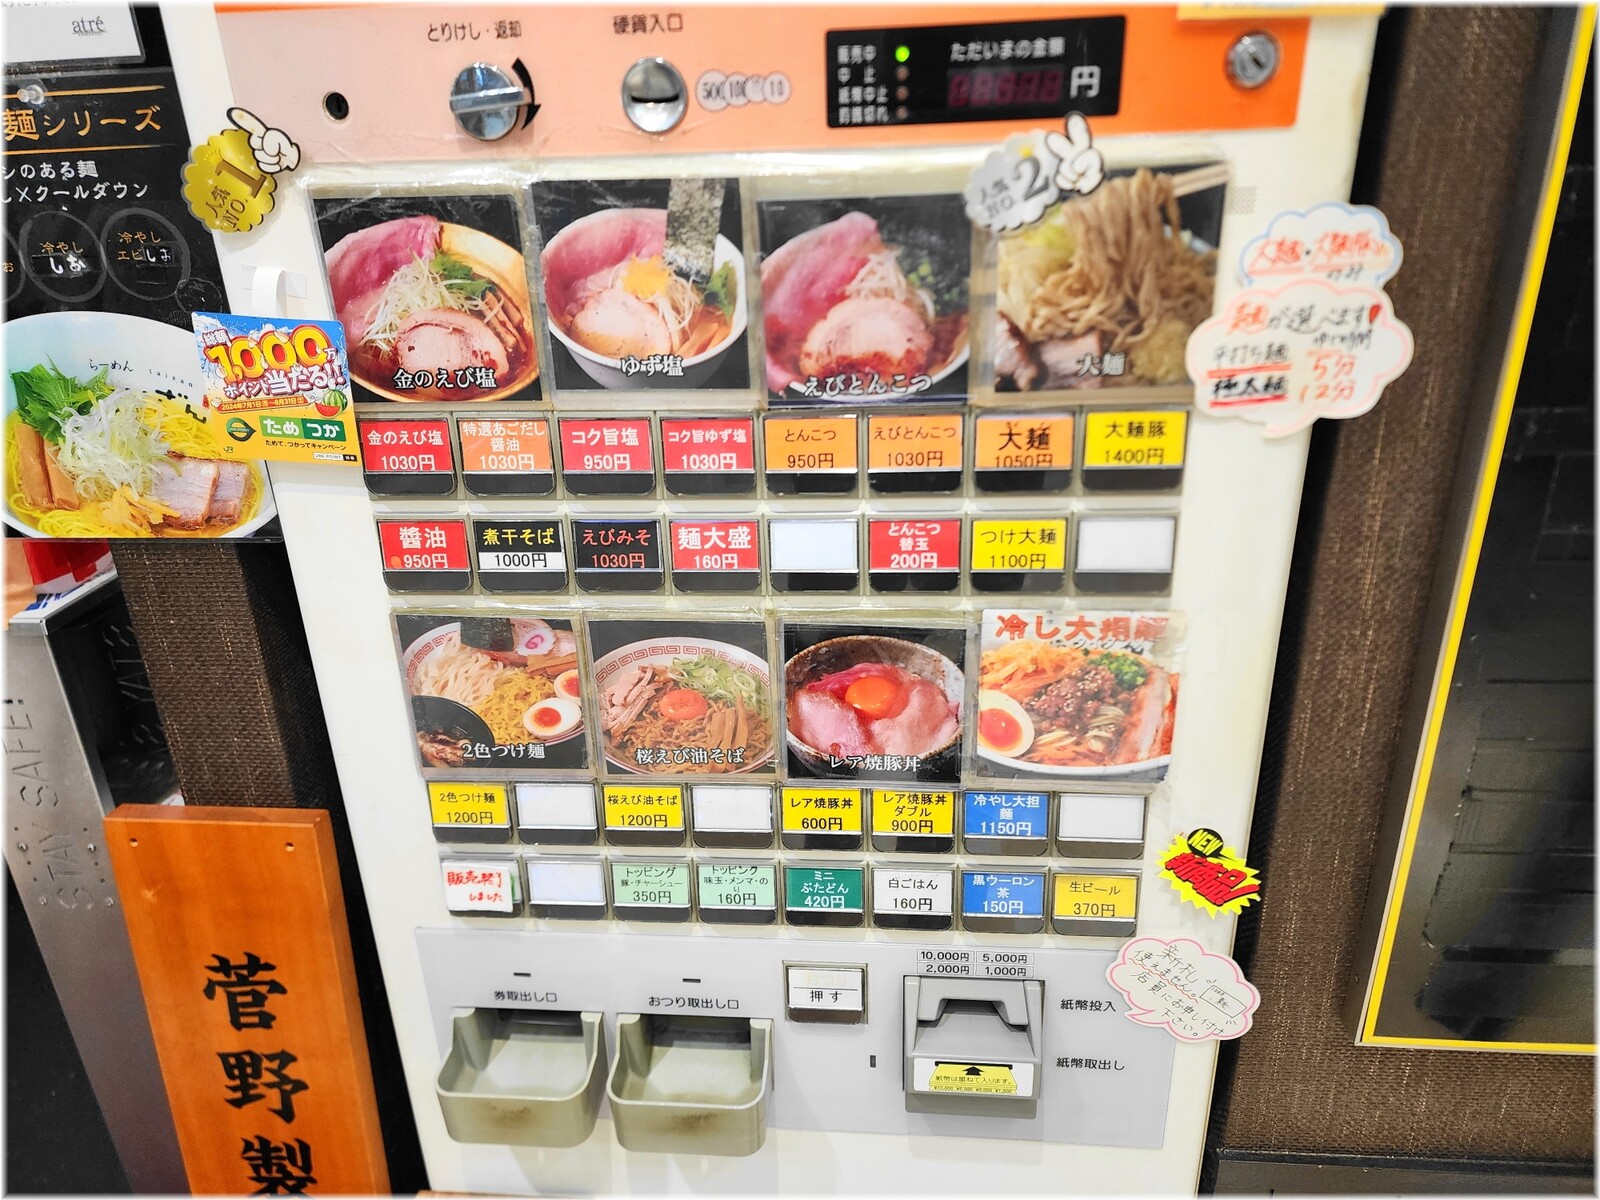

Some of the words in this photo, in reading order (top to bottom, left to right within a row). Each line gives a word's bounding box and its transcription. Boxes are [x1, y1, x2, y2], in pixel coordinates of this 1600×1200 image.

[71, 16, 107, 34] atré
[1069, 65, 1101, 99] 円
[214, 159, 267, 198] 1
[1013, 157, 1050, 201] 2
[206, 186, 231, 218] 人気
[118, 231, 161, 244] 冷やし
[40, 241, 83, 255] 冷やし
[89, 358, 134, 373] らーめん
[620, 356, 684, 376] ゆず塩
[394, 369, 497, 389] 金のえび塩
[803, 375, 933, 397] えびとんこつ
[262, 418, 300, 436] ため
[306, 422, 341, 438] つか
[462, 421, 546, 437] 特選あごだし
[784, 428, 837, 443] とんこつ
[874, 425, 957, 441] えびとんこつ
[367, 429, 444, 446] 金のえび塩
[571, 429, 640, 447] コク旨塩
[667, 428, 747, 444] コク旨ゆず塩
[490, 438, 522, 452] 醤油
[381, 454, 435, 470] 1030円
[479, 454, 535, 470] 1030円
[583, 454, 631, 470] 950円
[680, 453, 737, 470] 1030円
[787, 452, 834, 469] 950円
[887, 451, 944, 468] 1030円
[995, 453, 1053, 468] 1050円
[1104, 448, 1164, 465] 1400円
[482, 528, 555, 545] 煮干そば
[887, 522, 941, 536] とんこつ
[582, 528, 651, 546] えびみそ
[677, 527, 752, 550] 麺大盛
[899, 537, 929, 551] 替玉
[403, 554, 449, 569] 950円
[494, 553, 548, 568] 1000円
[591, 553, 646, 569] 1030円
[694, 554, 738, 569] 160円
[890, 553, 938, 569] 200円
[990, 554, 1046, 569] 1100円
[461, 743, 547, 759] 2色つけ麺
[635, 748, 745, 765] 桜えび油そば
[829, 754, 921, 772] レア焼豚丼
[439, 792, 496, 804] 2色つけ麺
[607, 794, 678, 807] 桜えび油そば
[790, 797, 854, 810] レア焼豚丼
[882, 793, 948, 806] レア焼豚丼
[973, 793, 1040, 809] 冷やし大担
[446, 812, 494, 825] 1200円
[894, 806, 932, 818] ダブル
[620, 815, 668, 828] 1200円
[801, 817, 843, 831] 600円
[891, 819, 934, 833] 900円
[980, 821, 1032, 836] 1150円
[1188, 829, 1222, 855] NEW
[447, 870, 503, 888] 販売終了
[625, 866, 677, 879] トッピング
[813, 871, 834, 881] ミニ
[800, 881, 849, 895] ぶたどん
[888, 878, 938, 891] 白ごはん
[972, 874, 1035, 887] 黒ウーロン
[1069, 881, 1121, 895] 生ビール
[469, 892, 503, 903] しました
[633, 891, 672, 904] 350円
[718, 893, 757, 905] 160円
[997, 887, 1010, 900] 茶
[804, 895, 845, 909] 420円
[893, 898, 933, 911] 160円
[982, 900, 1024, 914] 150円
[1073, 903, 1116, 917] 370円
[920, 951, 970, 962] 10,000円
[982, 953, 1028, 964] 5,000円
[926, 963, 970, 975] 2,000円
[984, 966, 1027, 977] 1,000円
[494, 990, 557, 1003] 券取出し口
[648, 995, 739, 1010] おつり取出し口
[809, 989, 842, 1003] 押す
[1060, 998, 1117, 1014] 紙幣投入
[1056, 1056, 1126, 1072] 紙幣取出し
